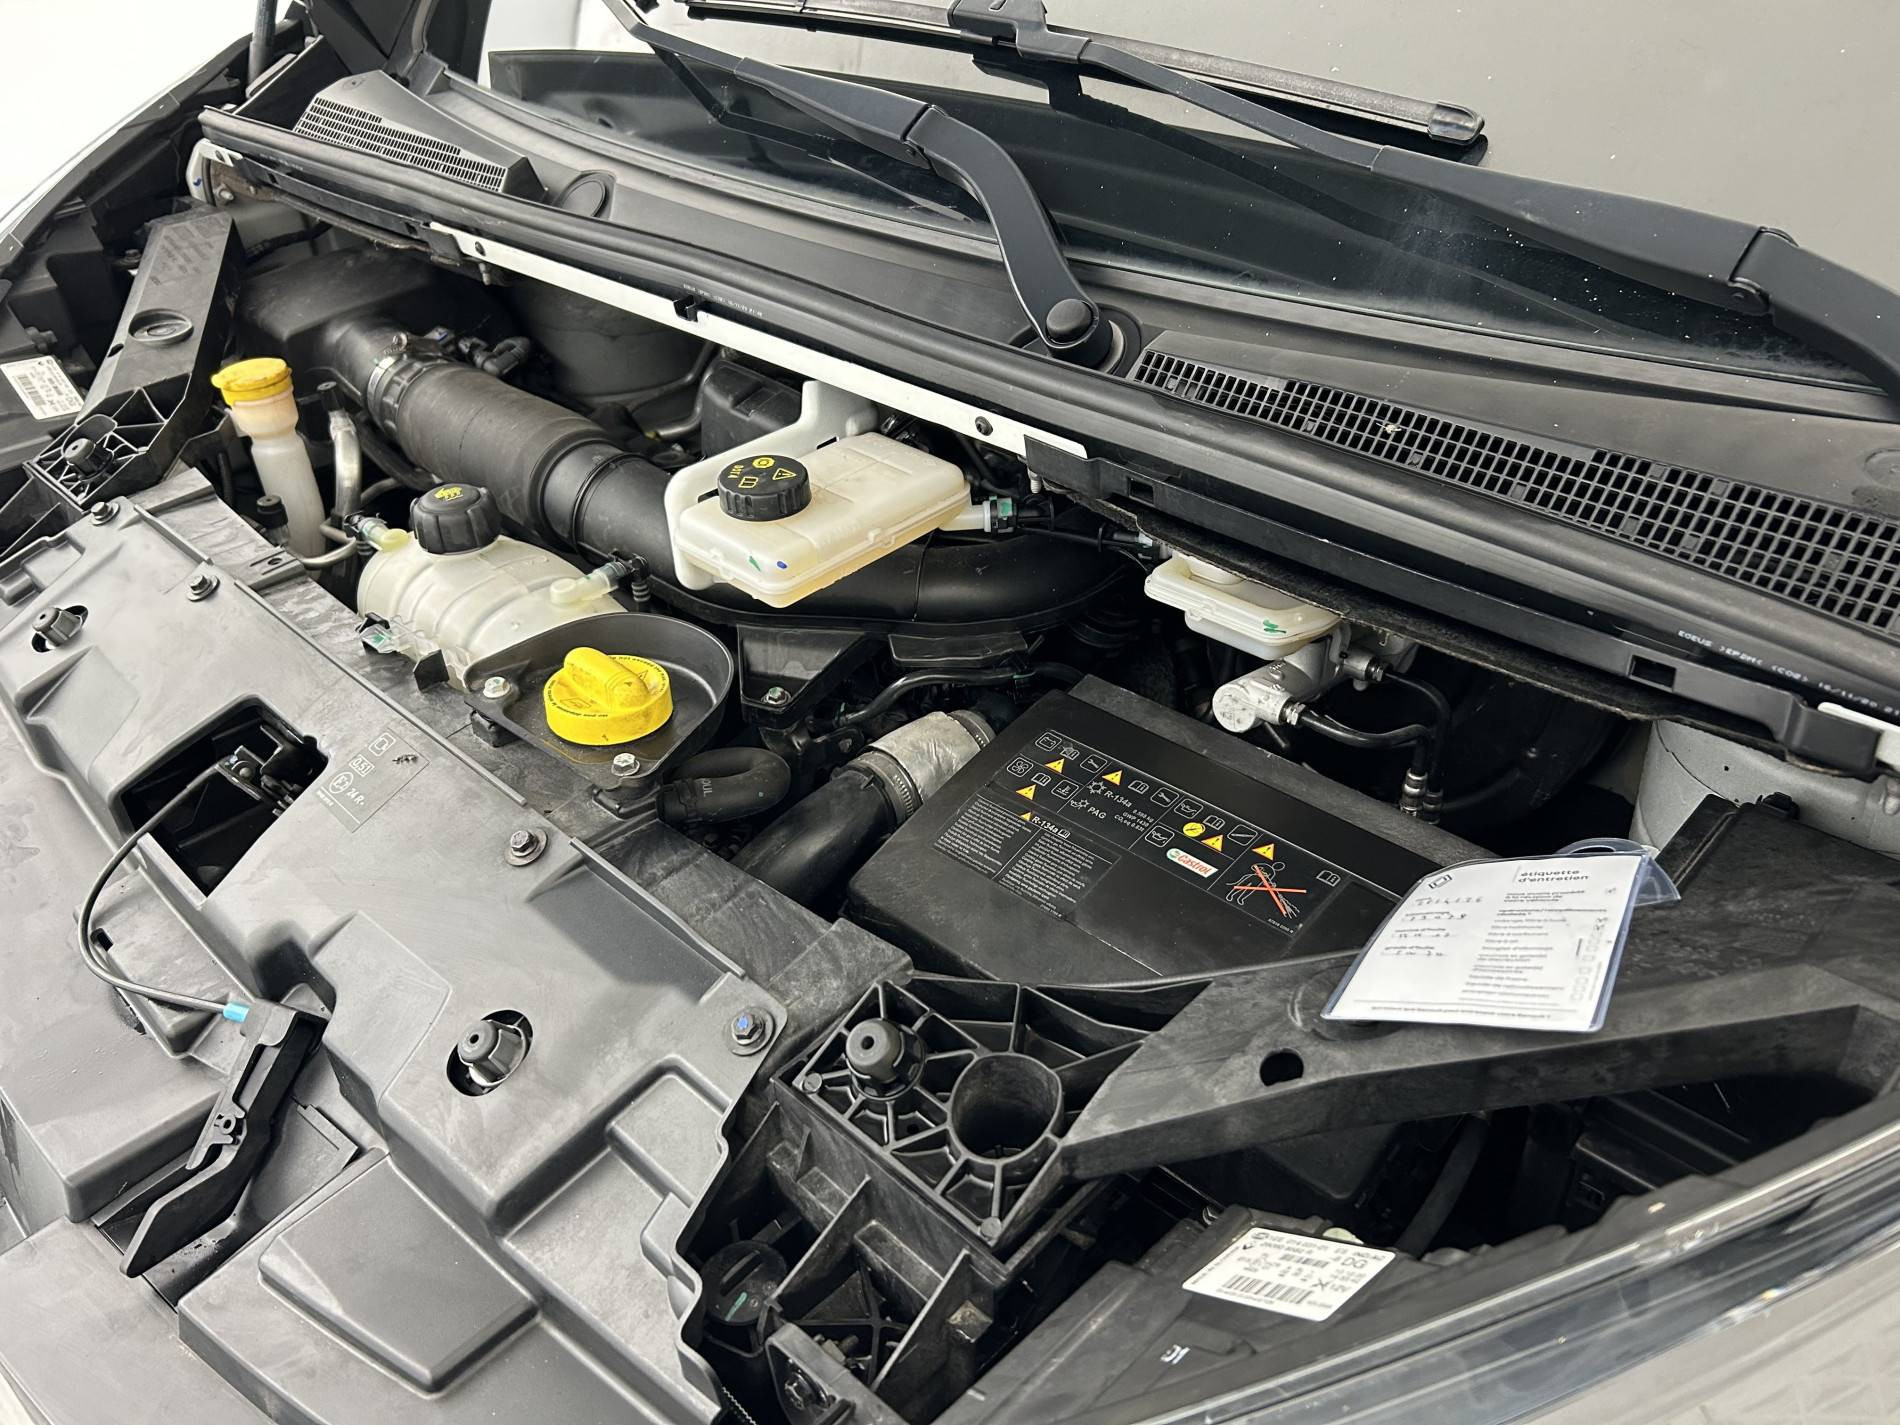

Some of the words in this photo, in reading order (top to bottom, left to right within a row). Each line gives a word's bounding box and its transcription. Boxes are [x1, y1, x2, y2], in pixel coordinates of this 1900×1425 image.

[1087, 806, 1107, 819] PAG
[1032, 816, 1058, 833] R-134a
[1177, 854, 1213, 875] Castrol
